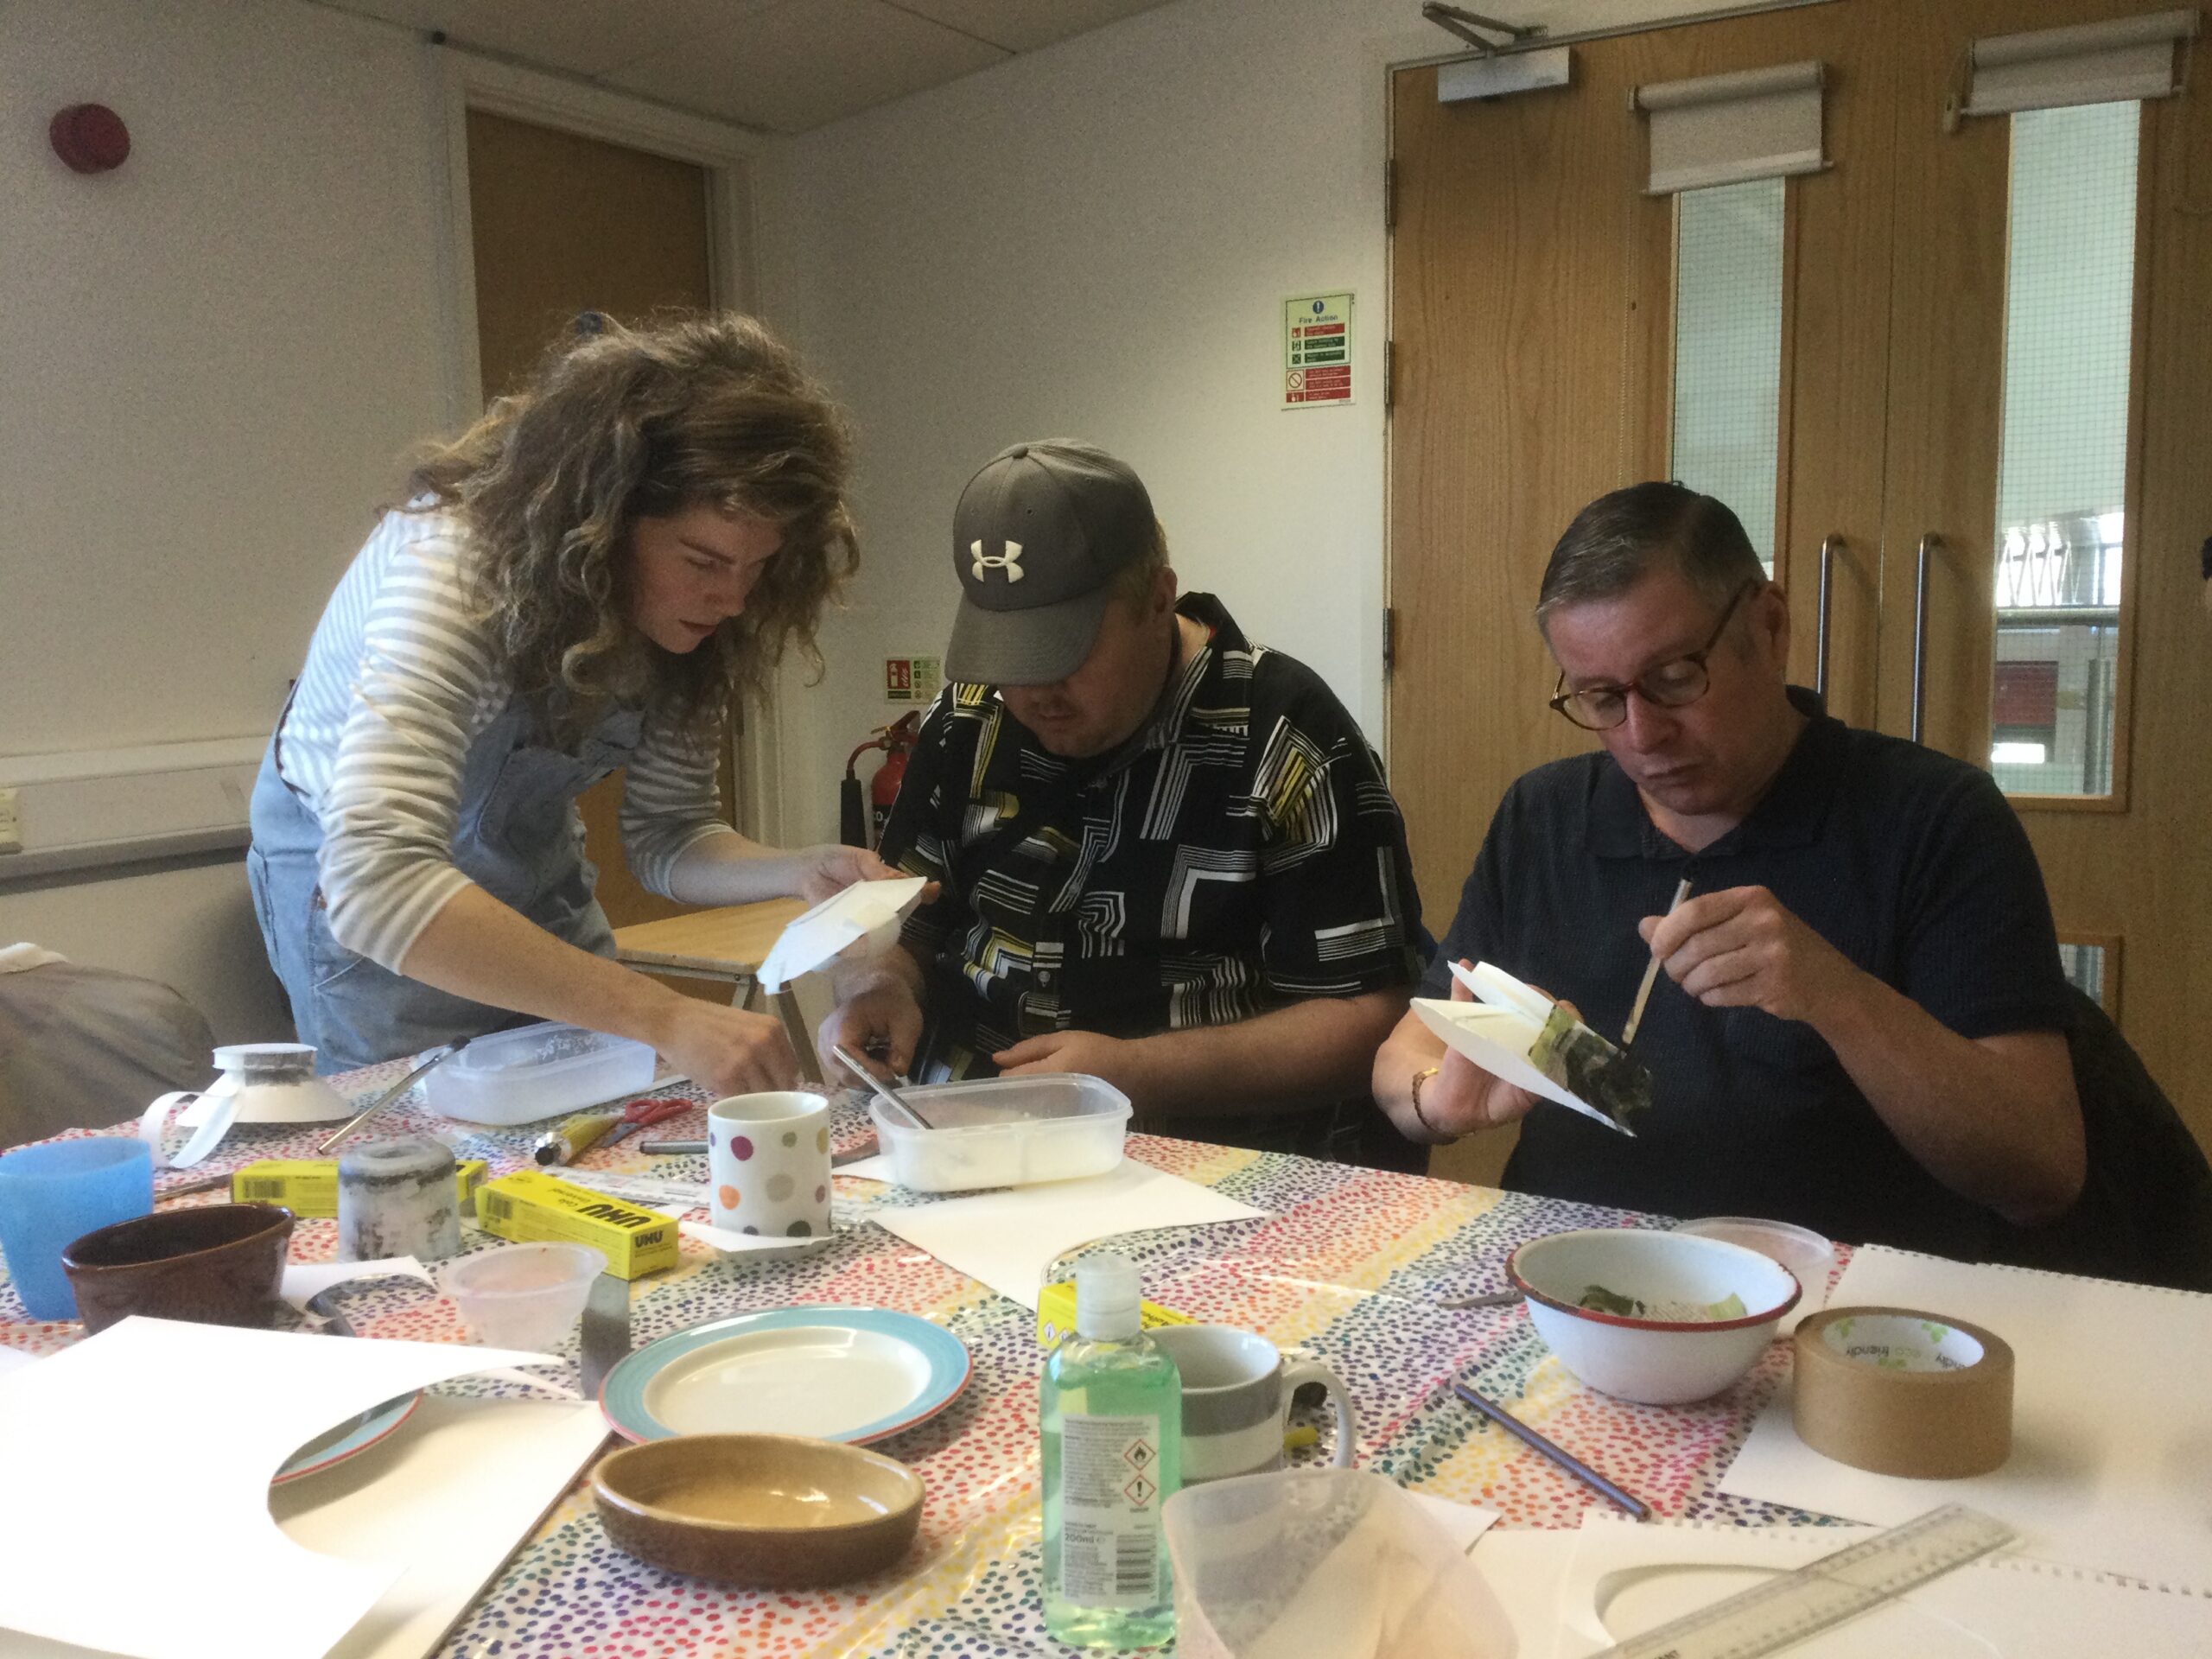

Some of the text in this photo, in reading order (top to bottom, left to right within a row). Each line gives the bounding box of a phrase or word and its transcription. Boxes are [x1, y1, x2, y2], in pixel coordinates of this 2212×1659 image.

[1315, 314, 1338, 322] Action
[576, 1204, 652, 1229] UHU
[634, 1230, 664, 1248] UHU
[1846, 1344, 1889, 1358] friendly
